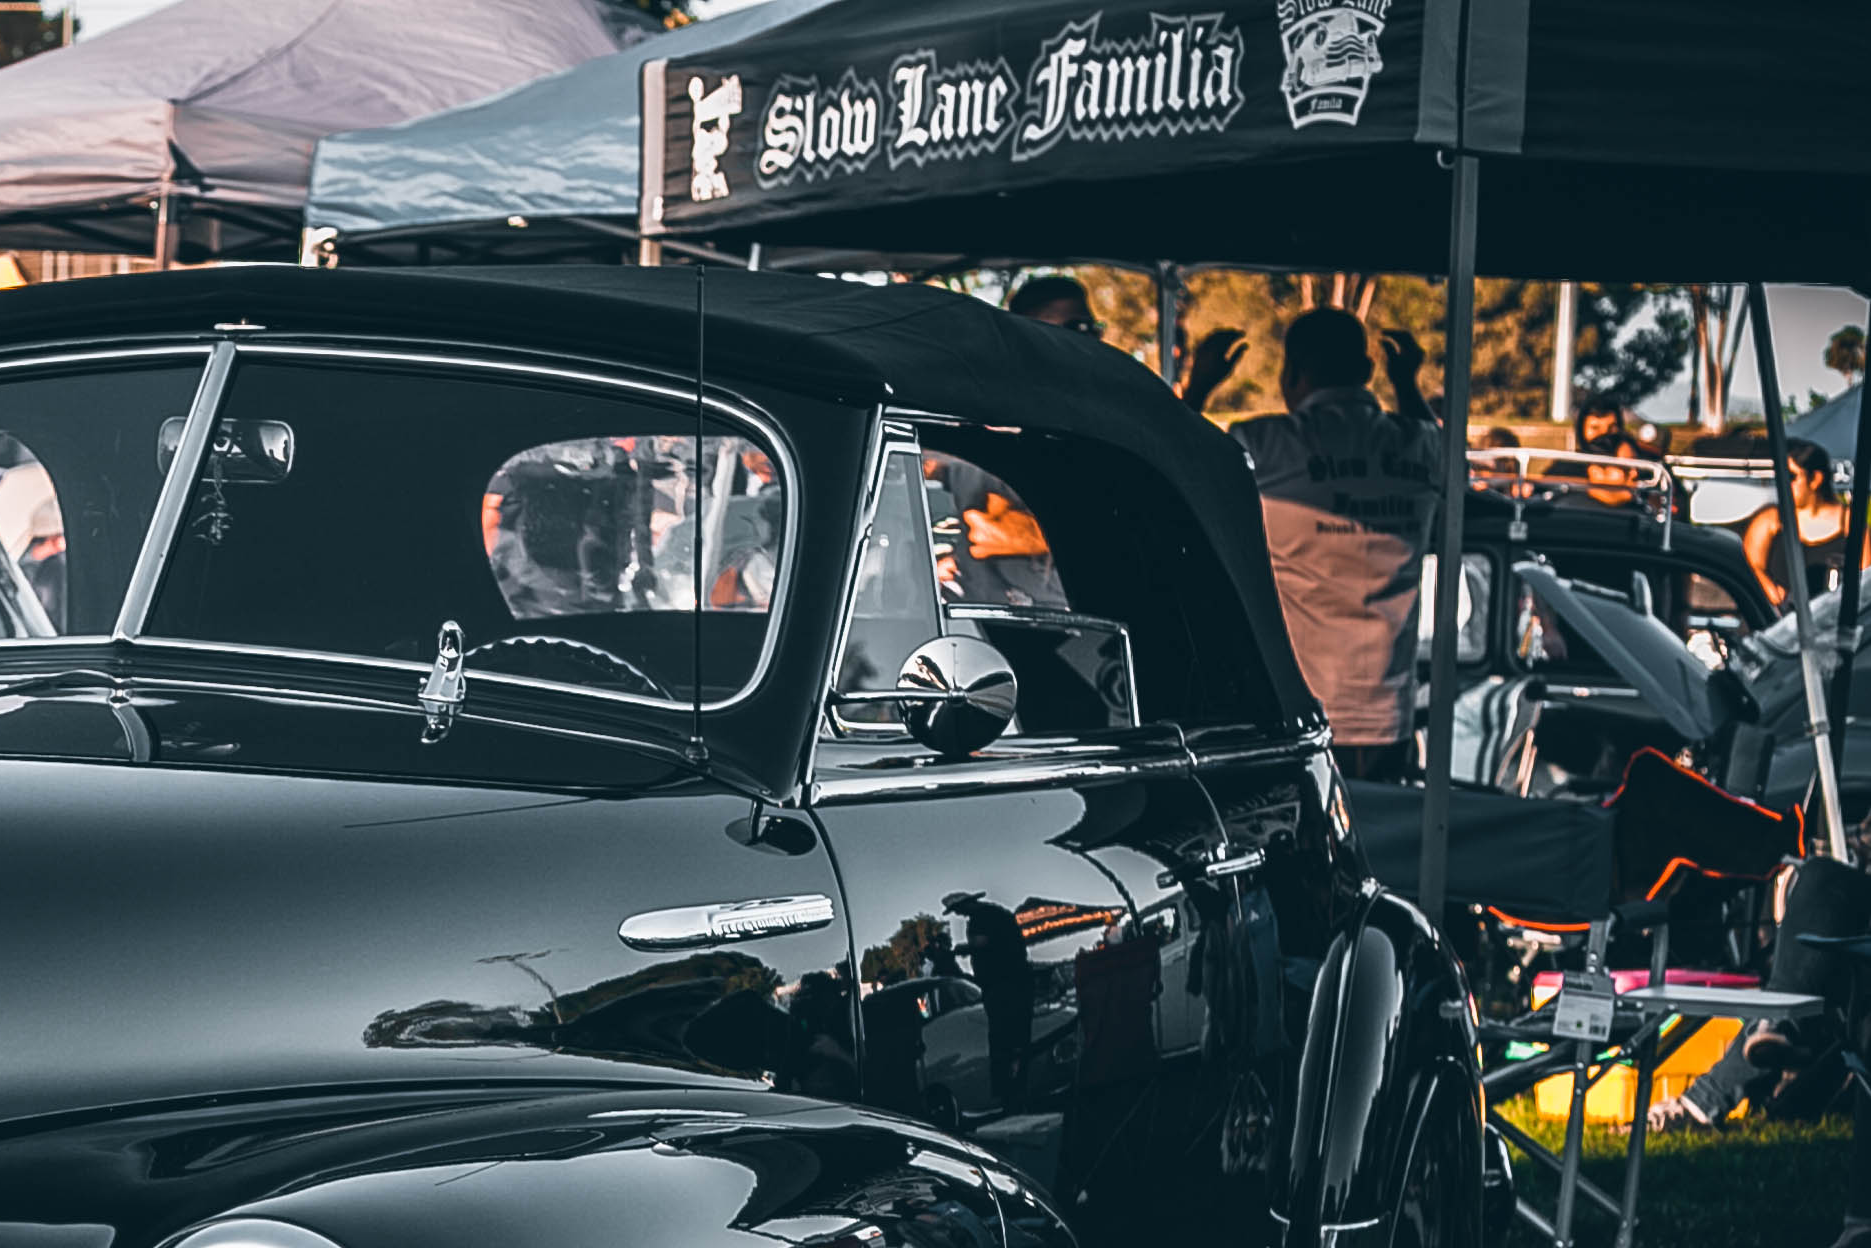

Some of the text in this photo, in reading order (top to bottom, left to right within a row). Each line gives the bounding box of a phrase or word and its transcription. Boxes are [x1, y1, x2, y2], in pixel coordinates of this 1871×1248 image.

[760, 28, 1234, 174] Slow Lane Familia
